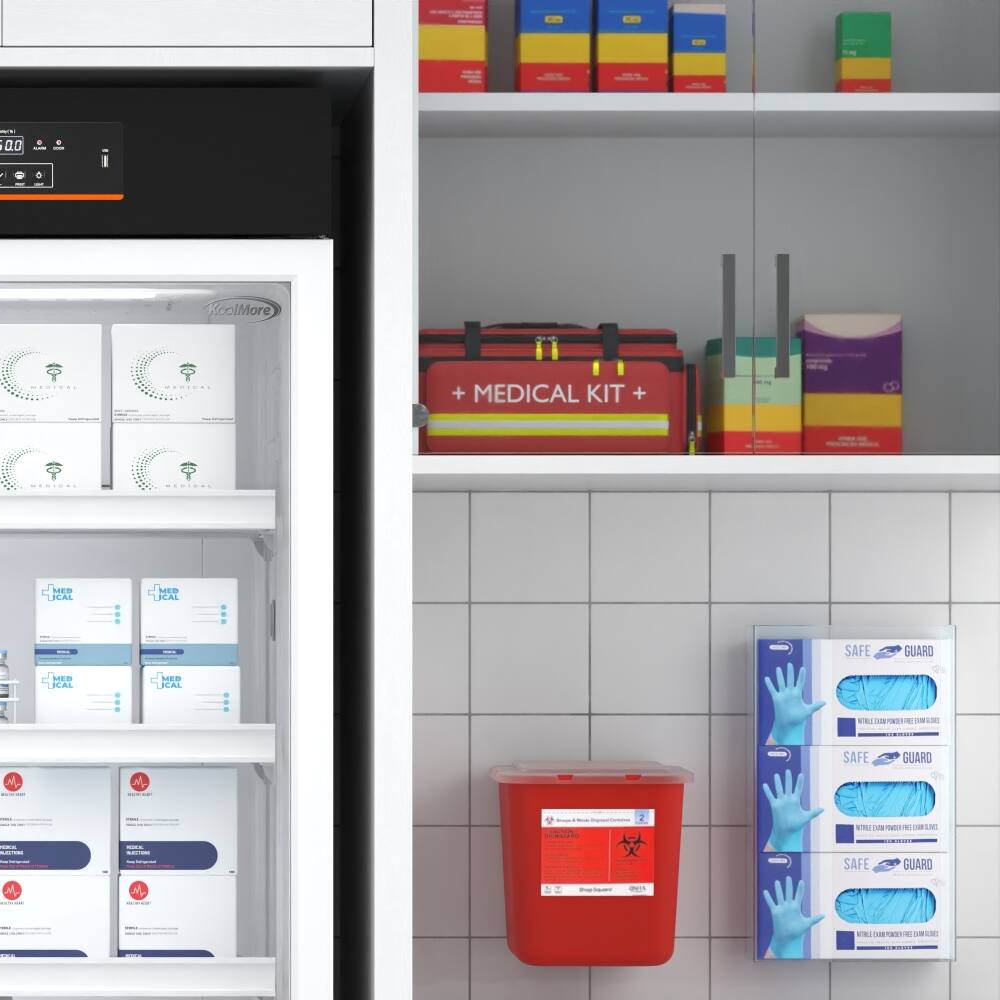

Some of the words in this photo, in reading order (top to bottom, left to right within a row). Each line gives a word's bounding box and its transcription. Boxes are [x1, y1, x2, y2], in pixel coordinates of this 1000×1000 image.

[474, 384, 579, 403] MEDICAL
[588, 384, 625, 403] KIT
[845, 645, 870, 657] SAFE
[905, 645, 934, 657] GUARD
[843, 751, 869, 763] SAFE
[903, 752, 932, 764] GUARD
[844, 858, 869, 870] SAFE
[904, 859, 932, 870] GUARD
